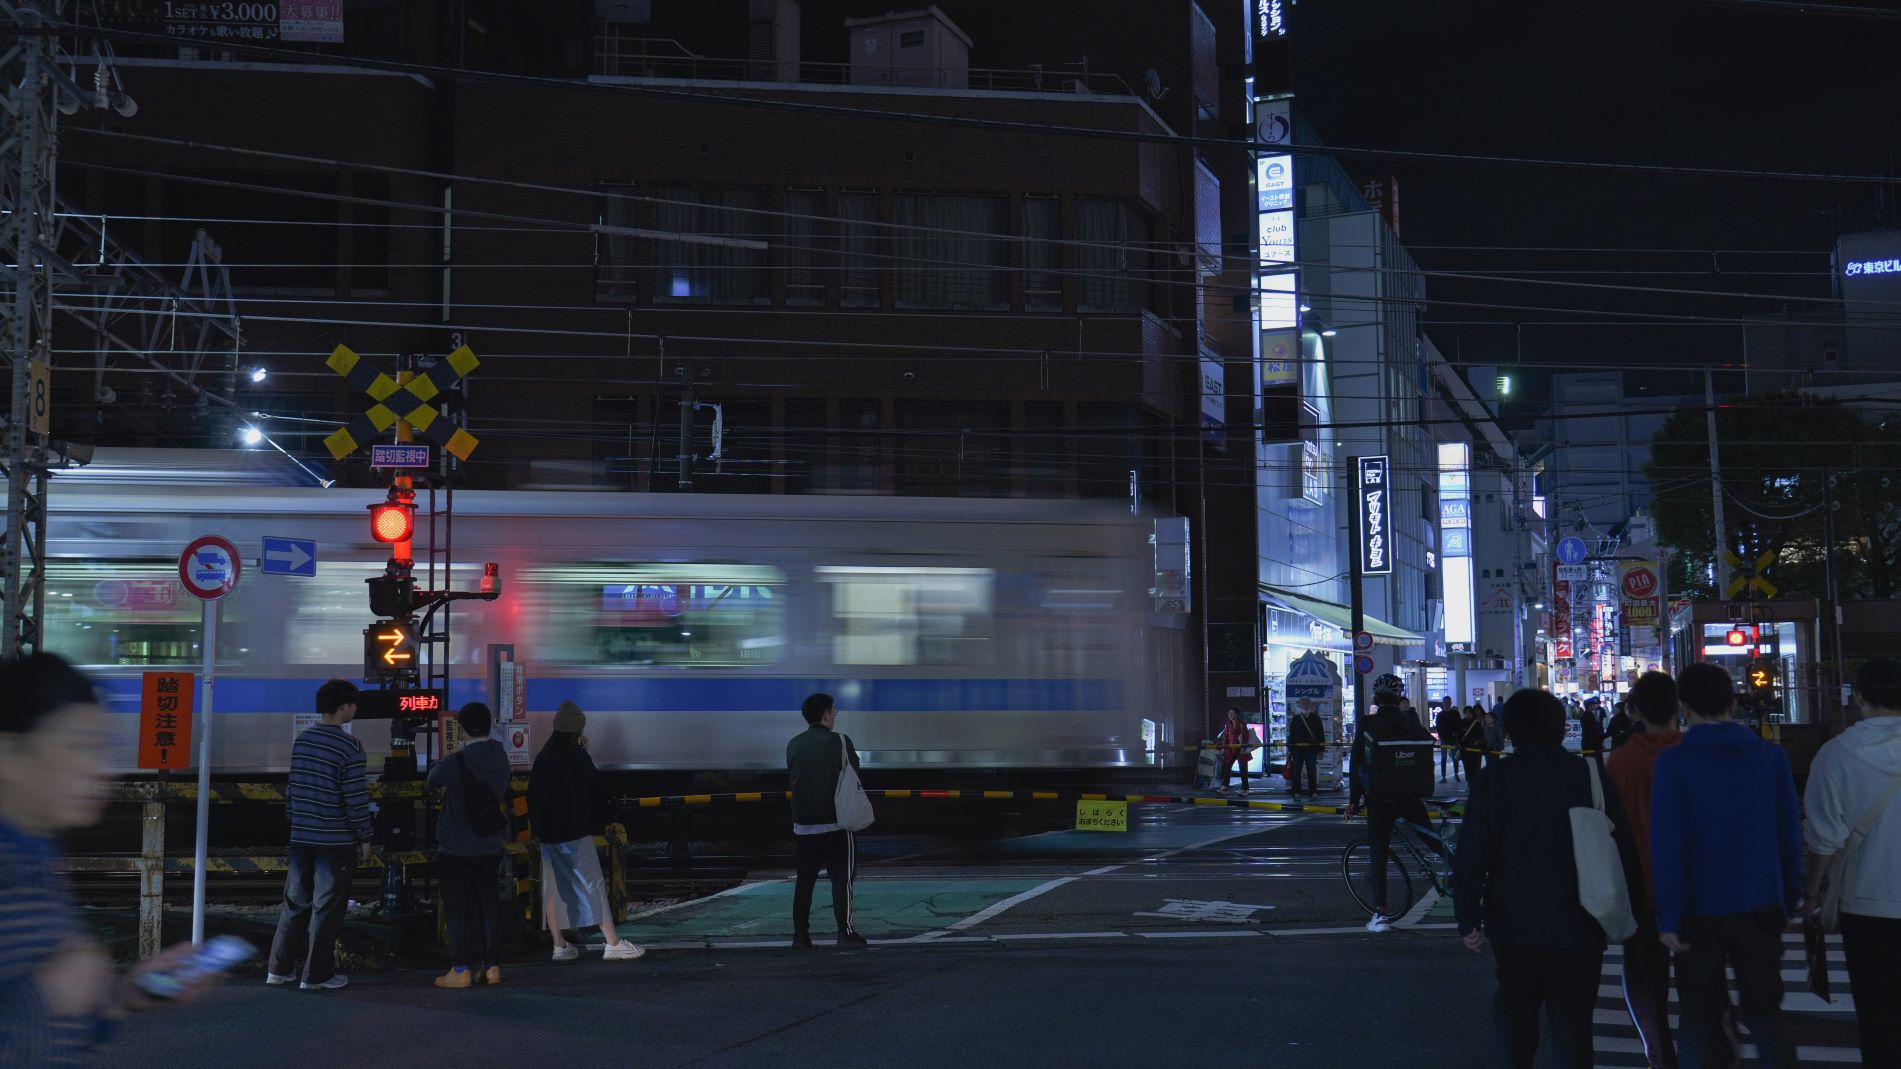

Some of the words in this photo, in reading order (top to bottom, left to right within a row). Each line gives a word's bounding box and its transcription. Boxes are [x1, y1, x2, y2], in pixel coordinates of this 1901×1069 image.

[1264, 200, 1288, 208] クリニック
[1266, 224, 1287, 234] club
[1862, 259, 1901, 274] 東京ビル
[36, 379, 45, 417] 8
[375, 448, 427, 463] 踏切監視中
[1442, 504, 1465, 515] AGA
[1629, 574, 1650, 589] PIA
[1360, 635, 1372, 646] 30
[154, 677, 180, 764] 踏切注意!
[1395, 751, 1416, 759] Uber
[1079, 808, 1125, 817] しばらく
[1078, 818, 1124, 826] おまちください
